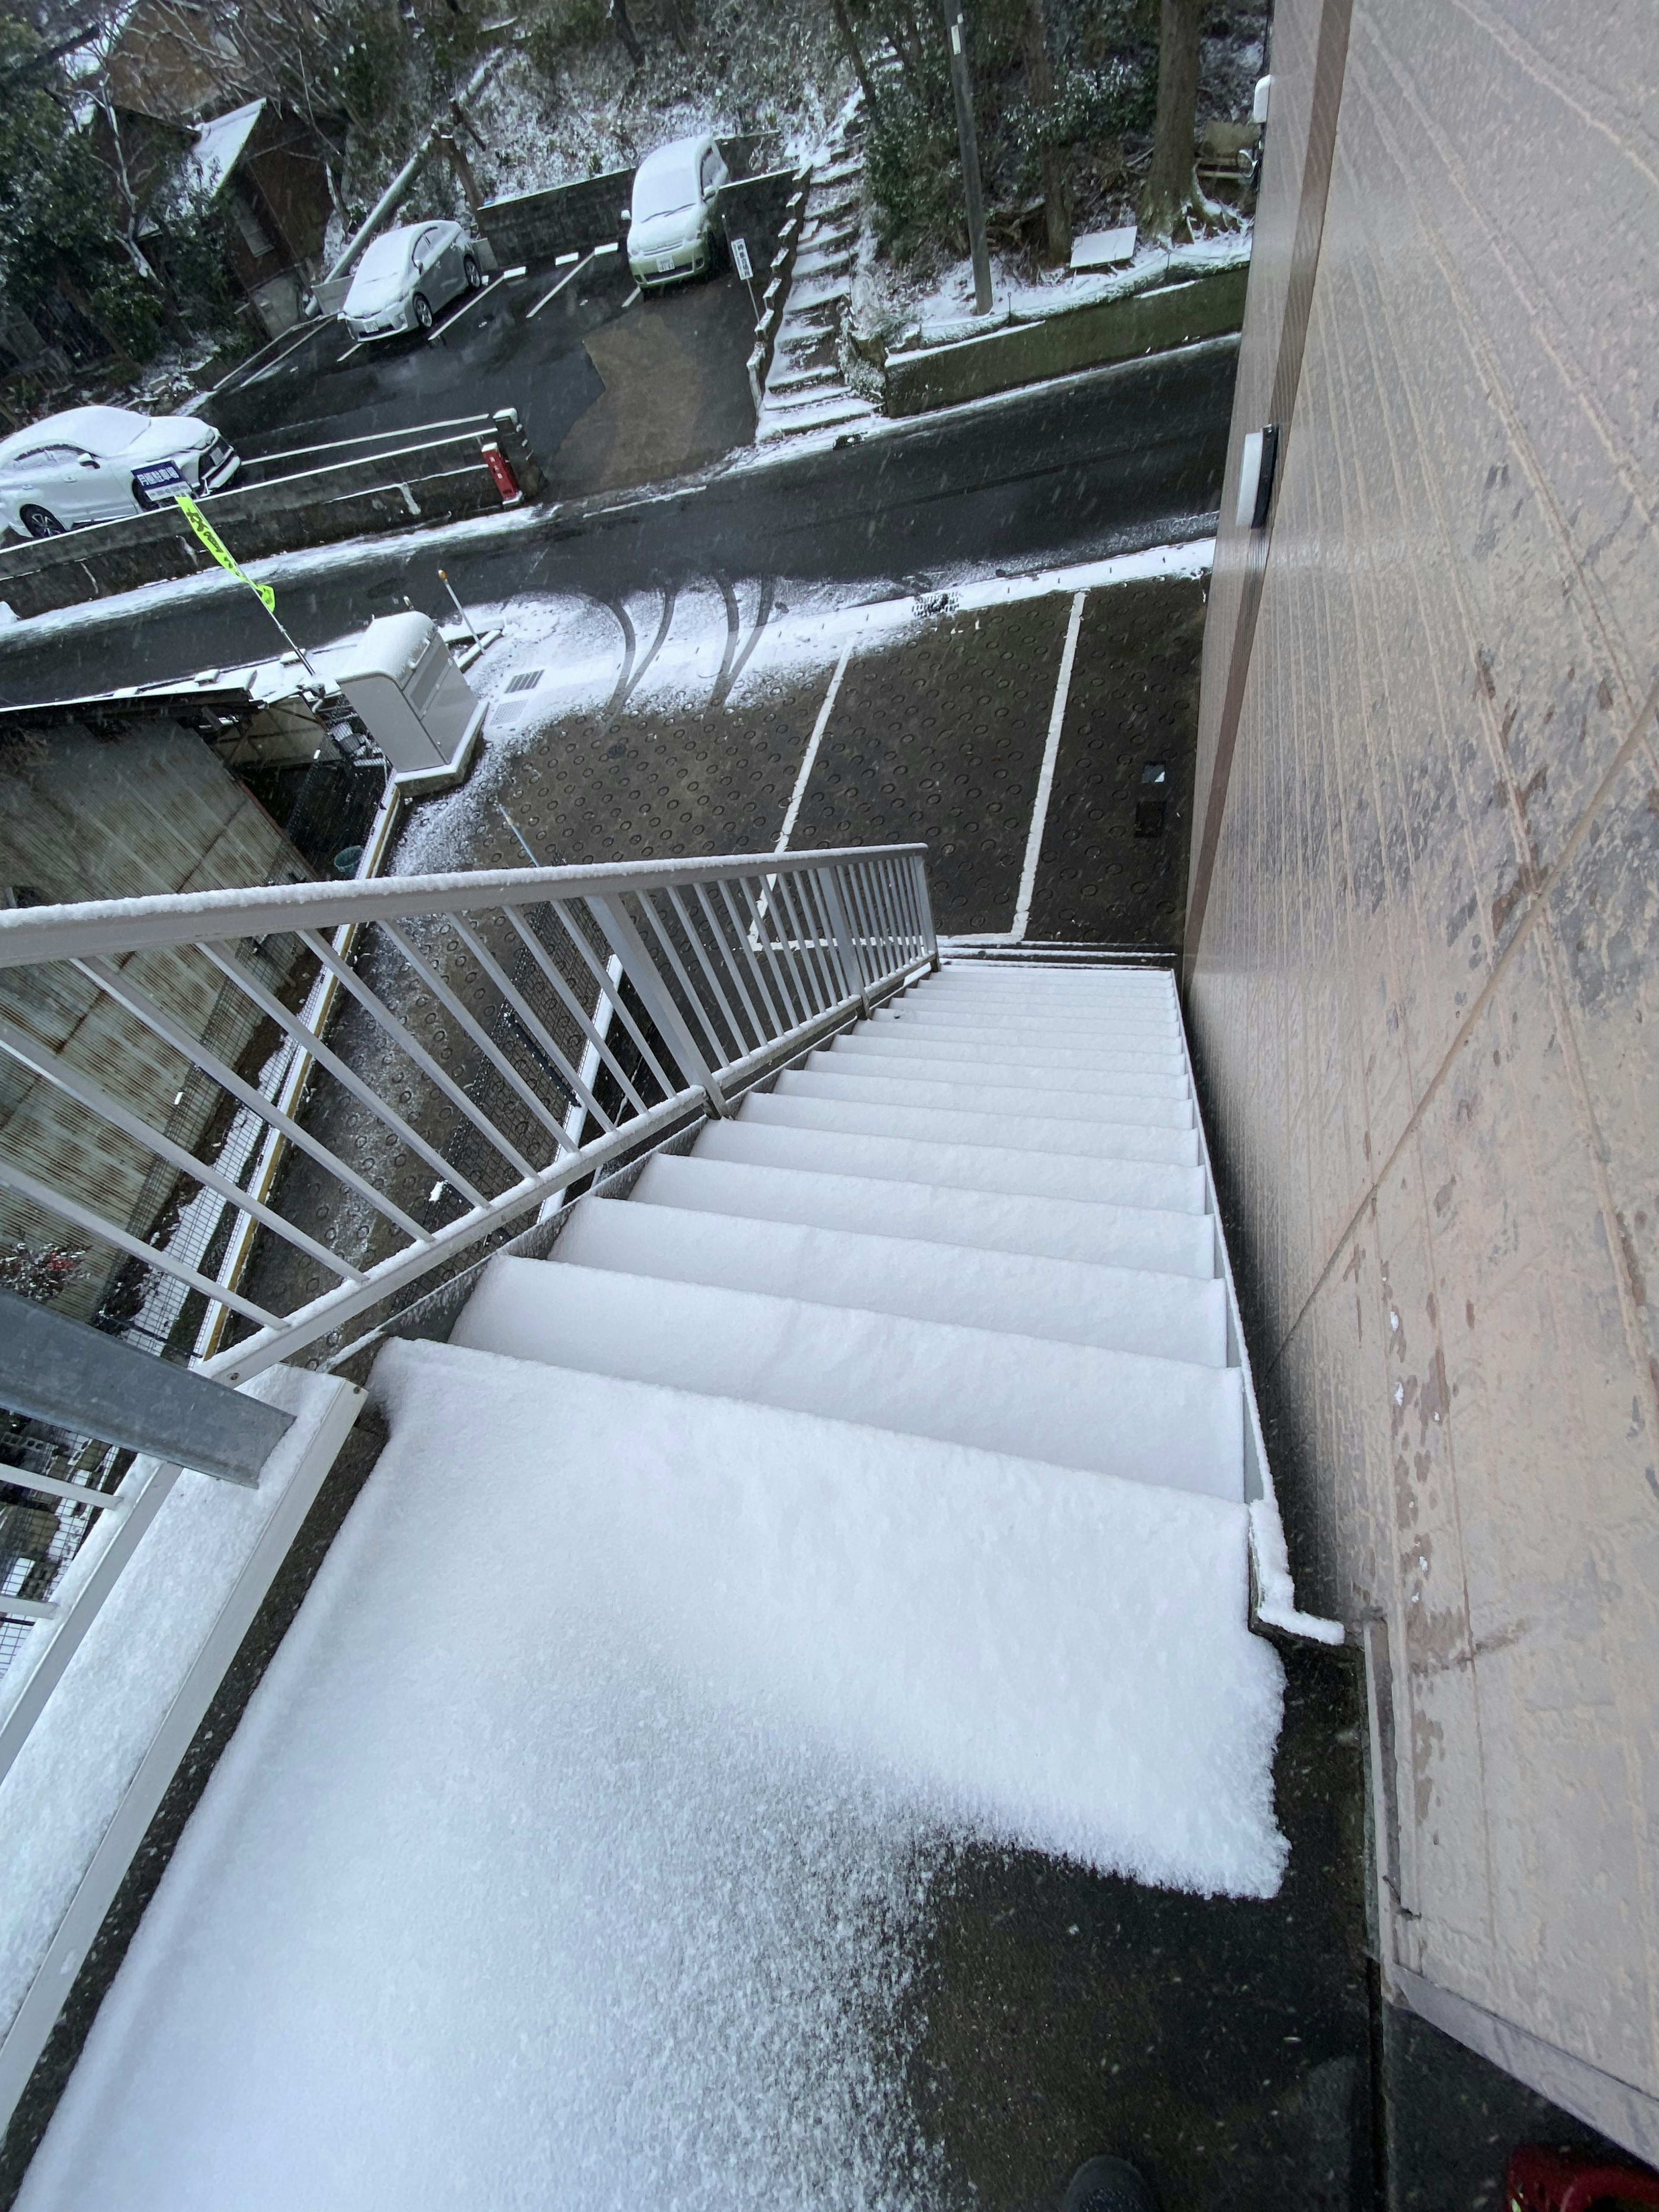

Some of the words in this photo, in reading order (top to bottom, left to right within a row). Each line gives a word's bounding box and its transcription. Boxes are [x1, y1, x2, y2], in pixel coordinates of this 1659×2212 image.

[137, 467, 180, 485] 月極駐車場
